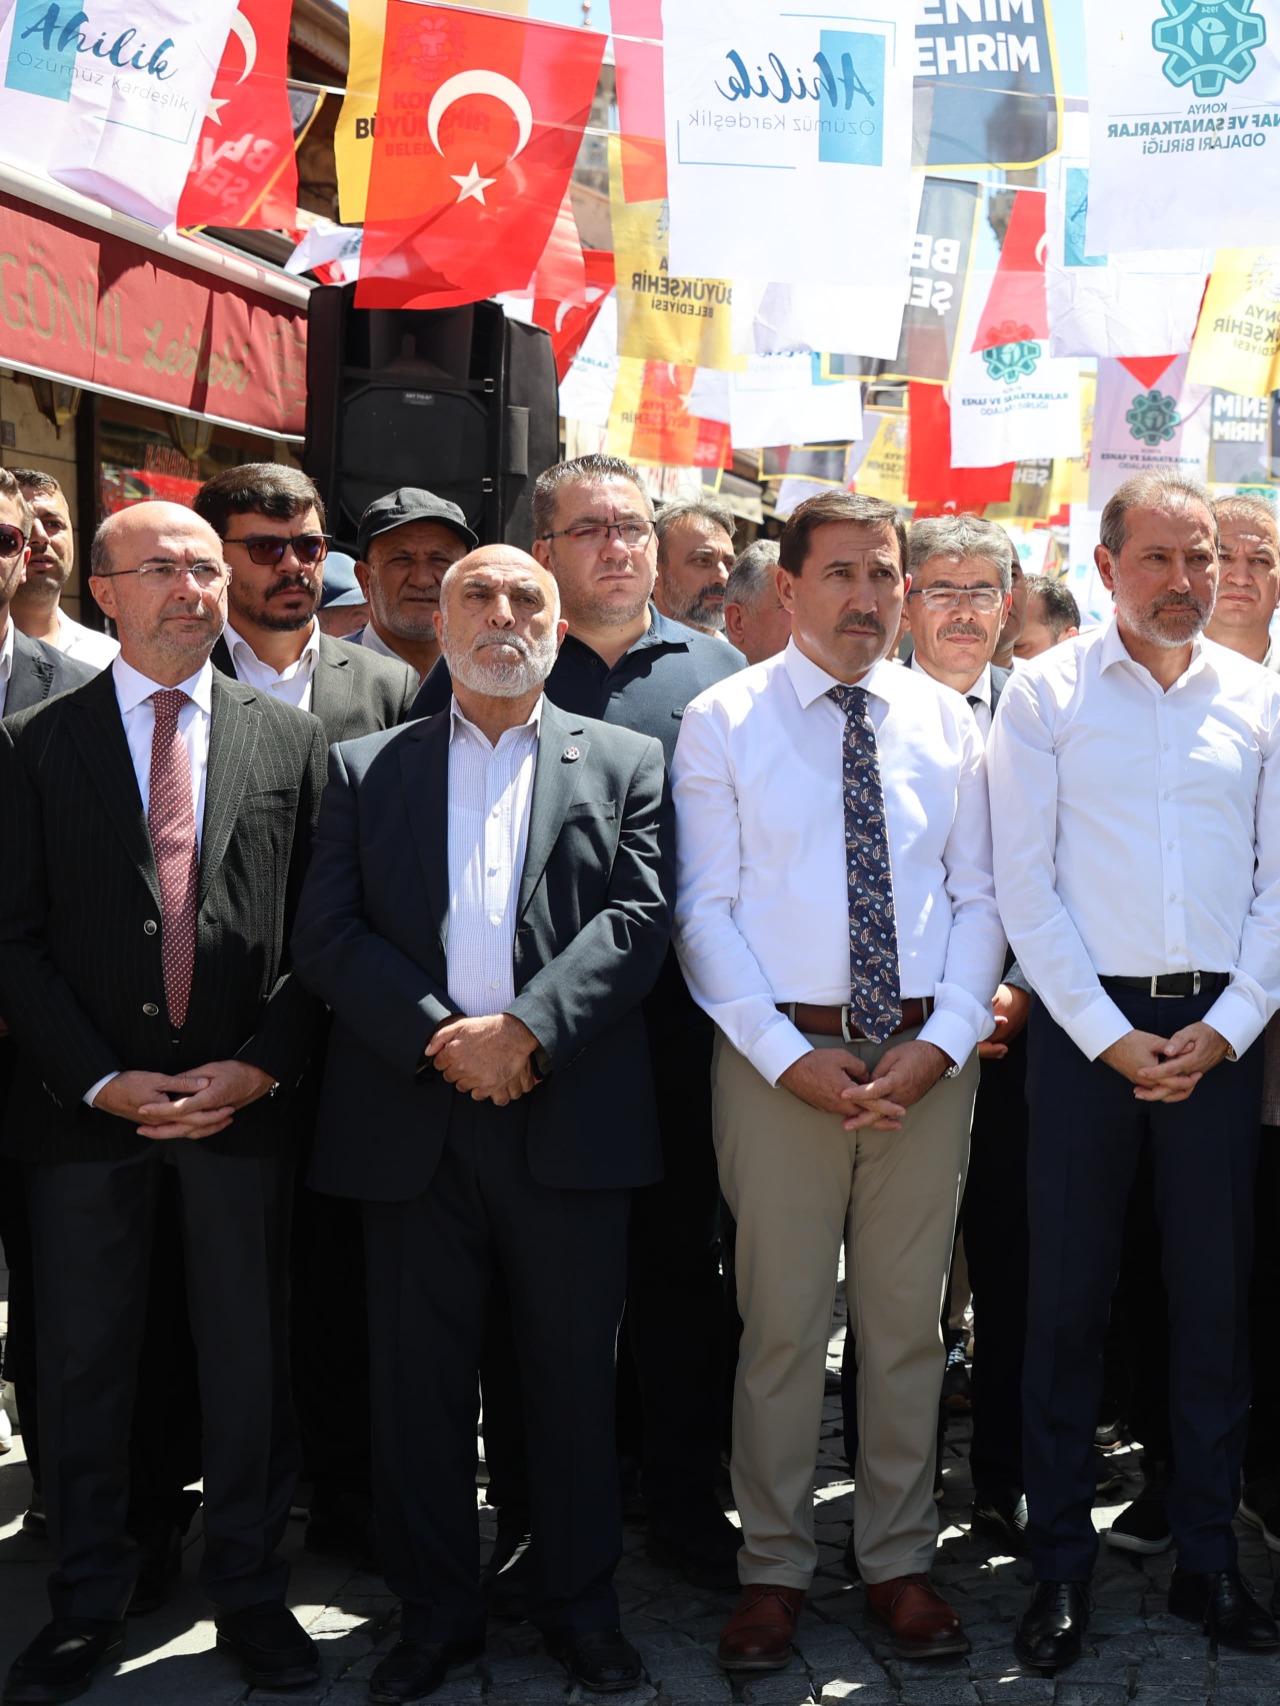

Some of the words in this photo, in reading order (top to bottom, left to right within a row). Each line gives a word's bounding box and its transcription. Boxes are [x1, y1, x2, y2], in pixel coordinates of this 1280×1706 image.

[21, 2, 178, 81] Ahilik
[912, 32, 1041, 76] EHRİM
[16, 49, 104, 86] Özümüz
[111, 76, 190, 113] Kardeşlik
[0, 242, 131, 364] GÖNÜL
